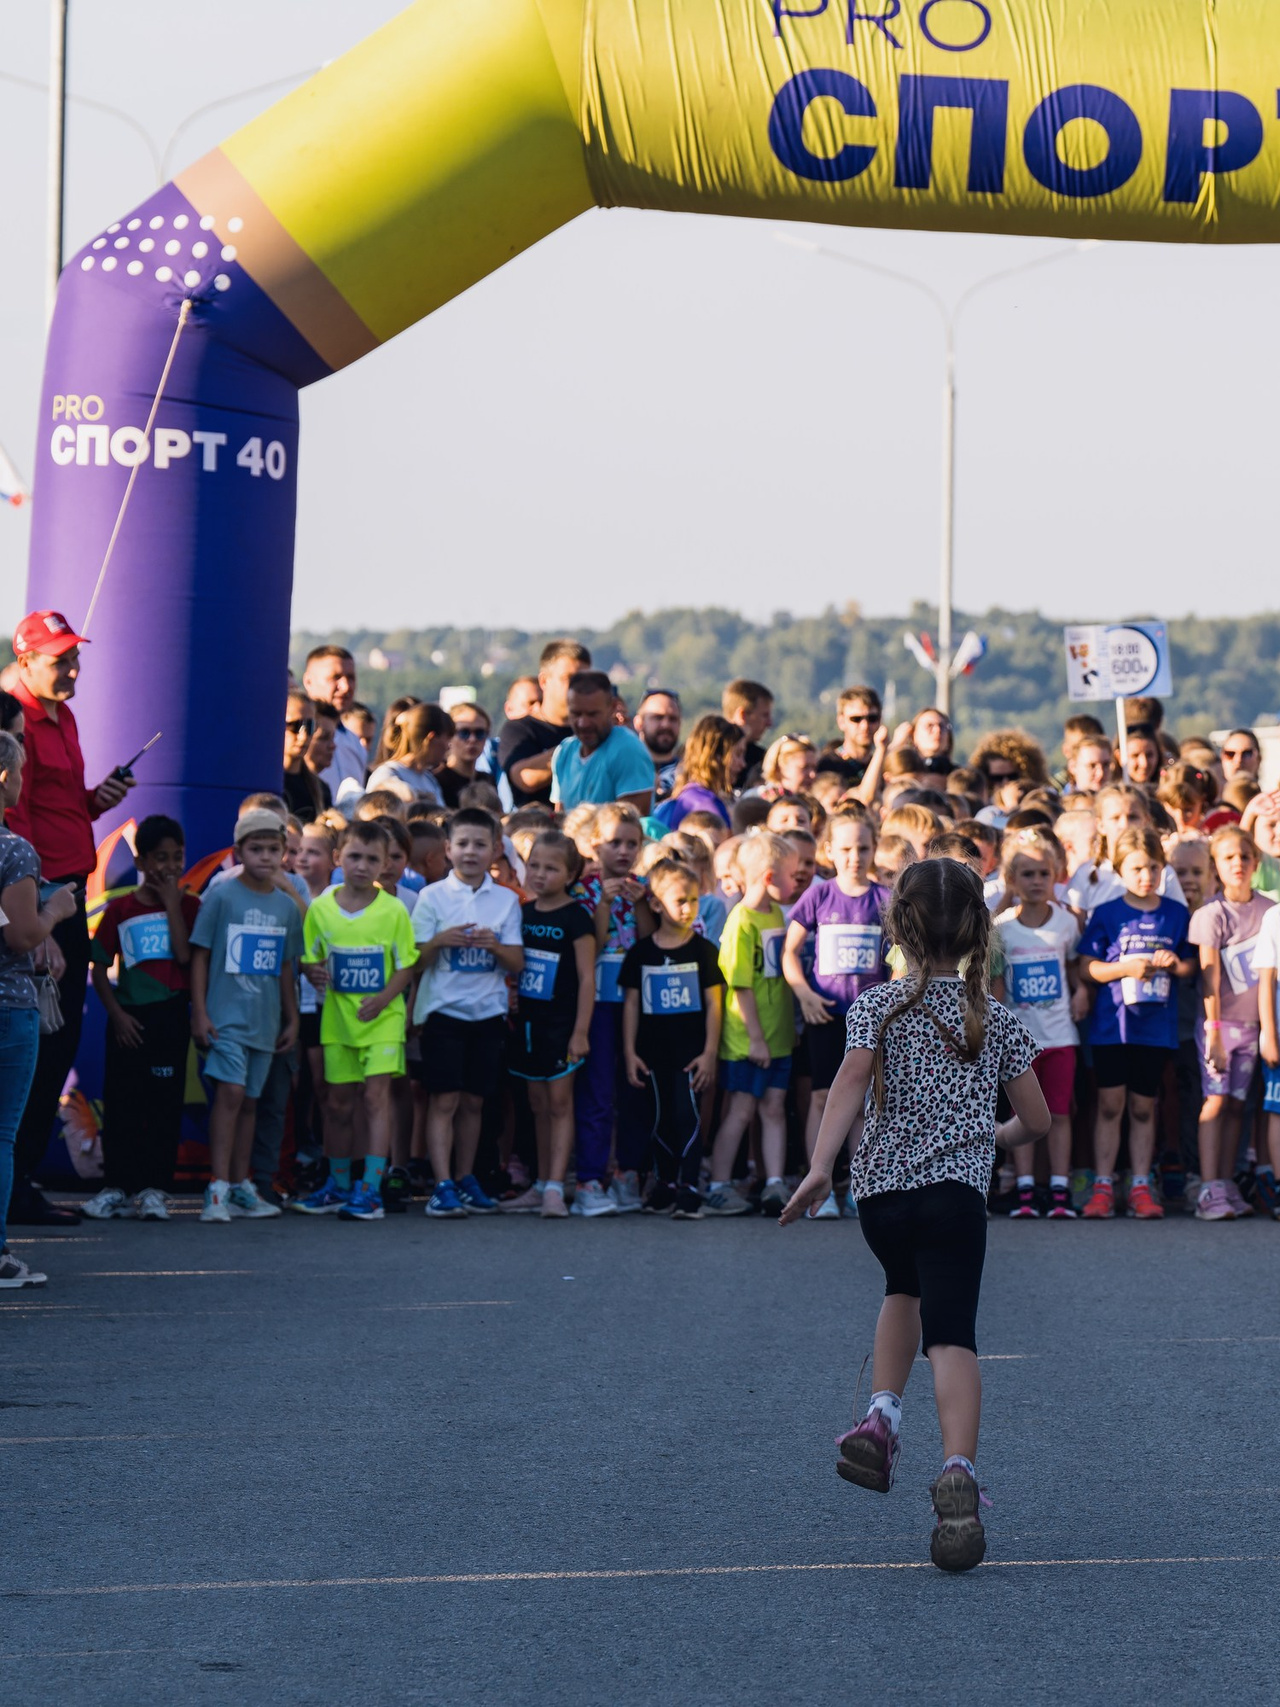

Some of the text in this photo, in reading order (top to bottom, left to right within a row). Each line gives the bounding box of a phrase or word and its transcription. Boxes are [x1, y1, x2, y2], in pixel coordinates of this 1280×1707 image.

[773, 0, 991, 52] PRO
[52, 394, 105, 421] PRO
[50, 424, 286, 481] СПОРТ 40
[253, 951, 277, 970] 826
[458, 947, 494, 967] 3044
[838, 948, 876, 969] 3929
[340, 968, 380, 988] 2702
[1018, 975, 1058, 998] 3822
[660, 987, 691, 1009] 954
